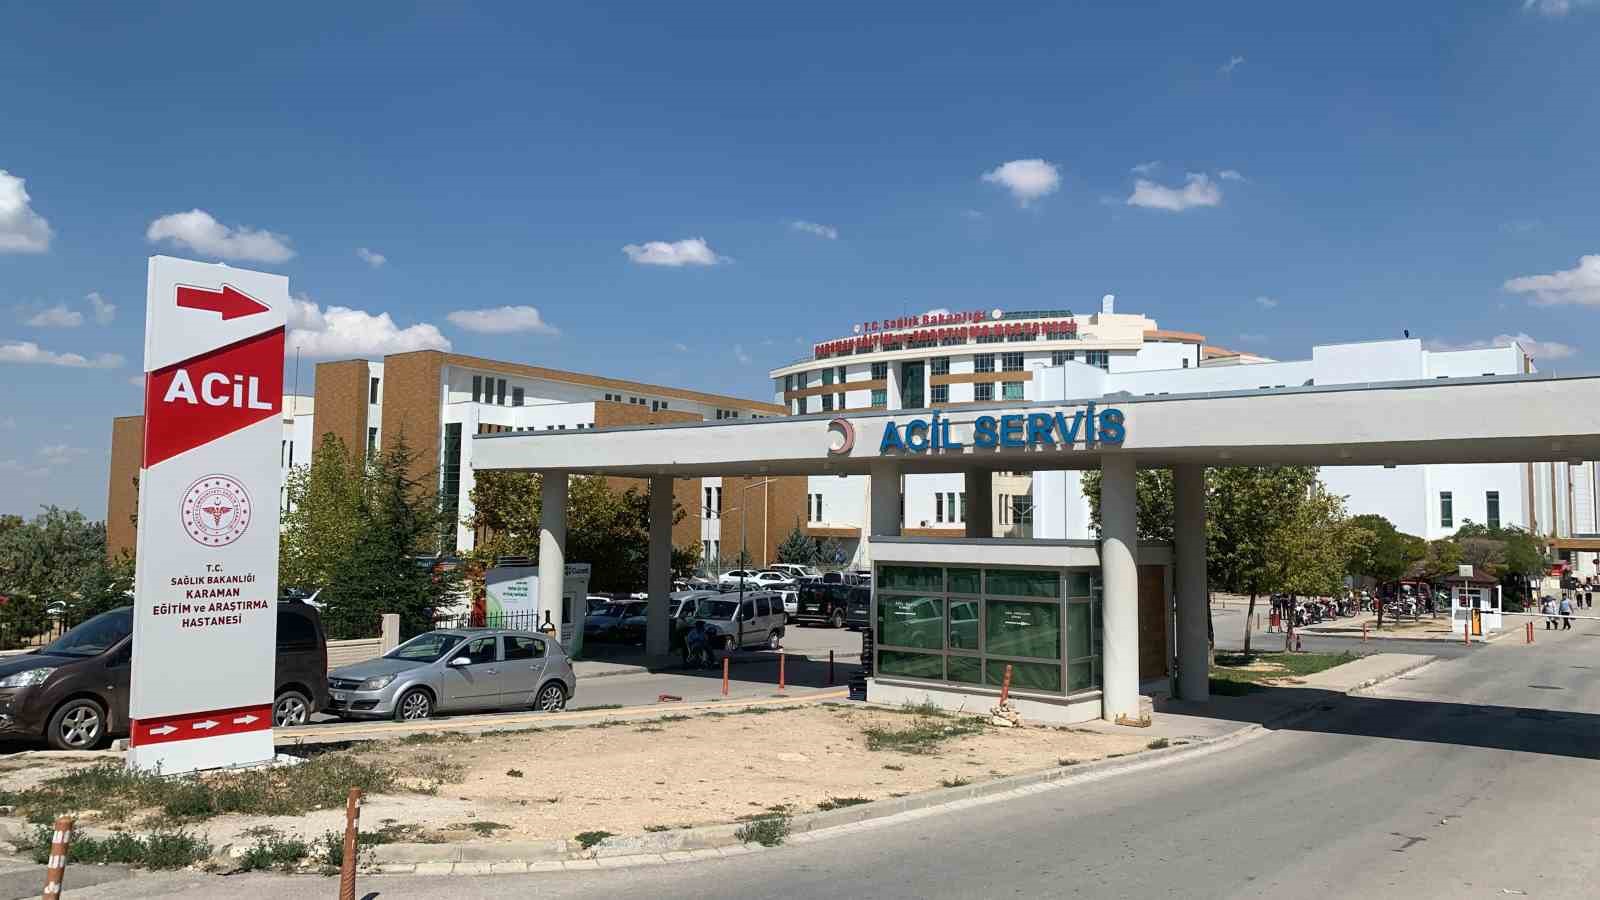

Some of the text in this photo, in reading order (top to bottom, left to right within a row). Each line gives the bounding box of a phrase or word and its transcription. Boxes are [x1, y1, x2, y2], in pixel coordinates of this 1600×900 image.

[881, 400, 1127, 452] ACİL SERVİS
[206, 564, 223, 573] T.C.
[170, 573, 256, 586] SAĞLIK BAKANLIĞI
[186, 588, 240, 599] KARAMAN
[153, 600, 268, 616] EĞİTİM ve ARAŞTIRMA
[182, 615, 242, 628] HASTANESİ
